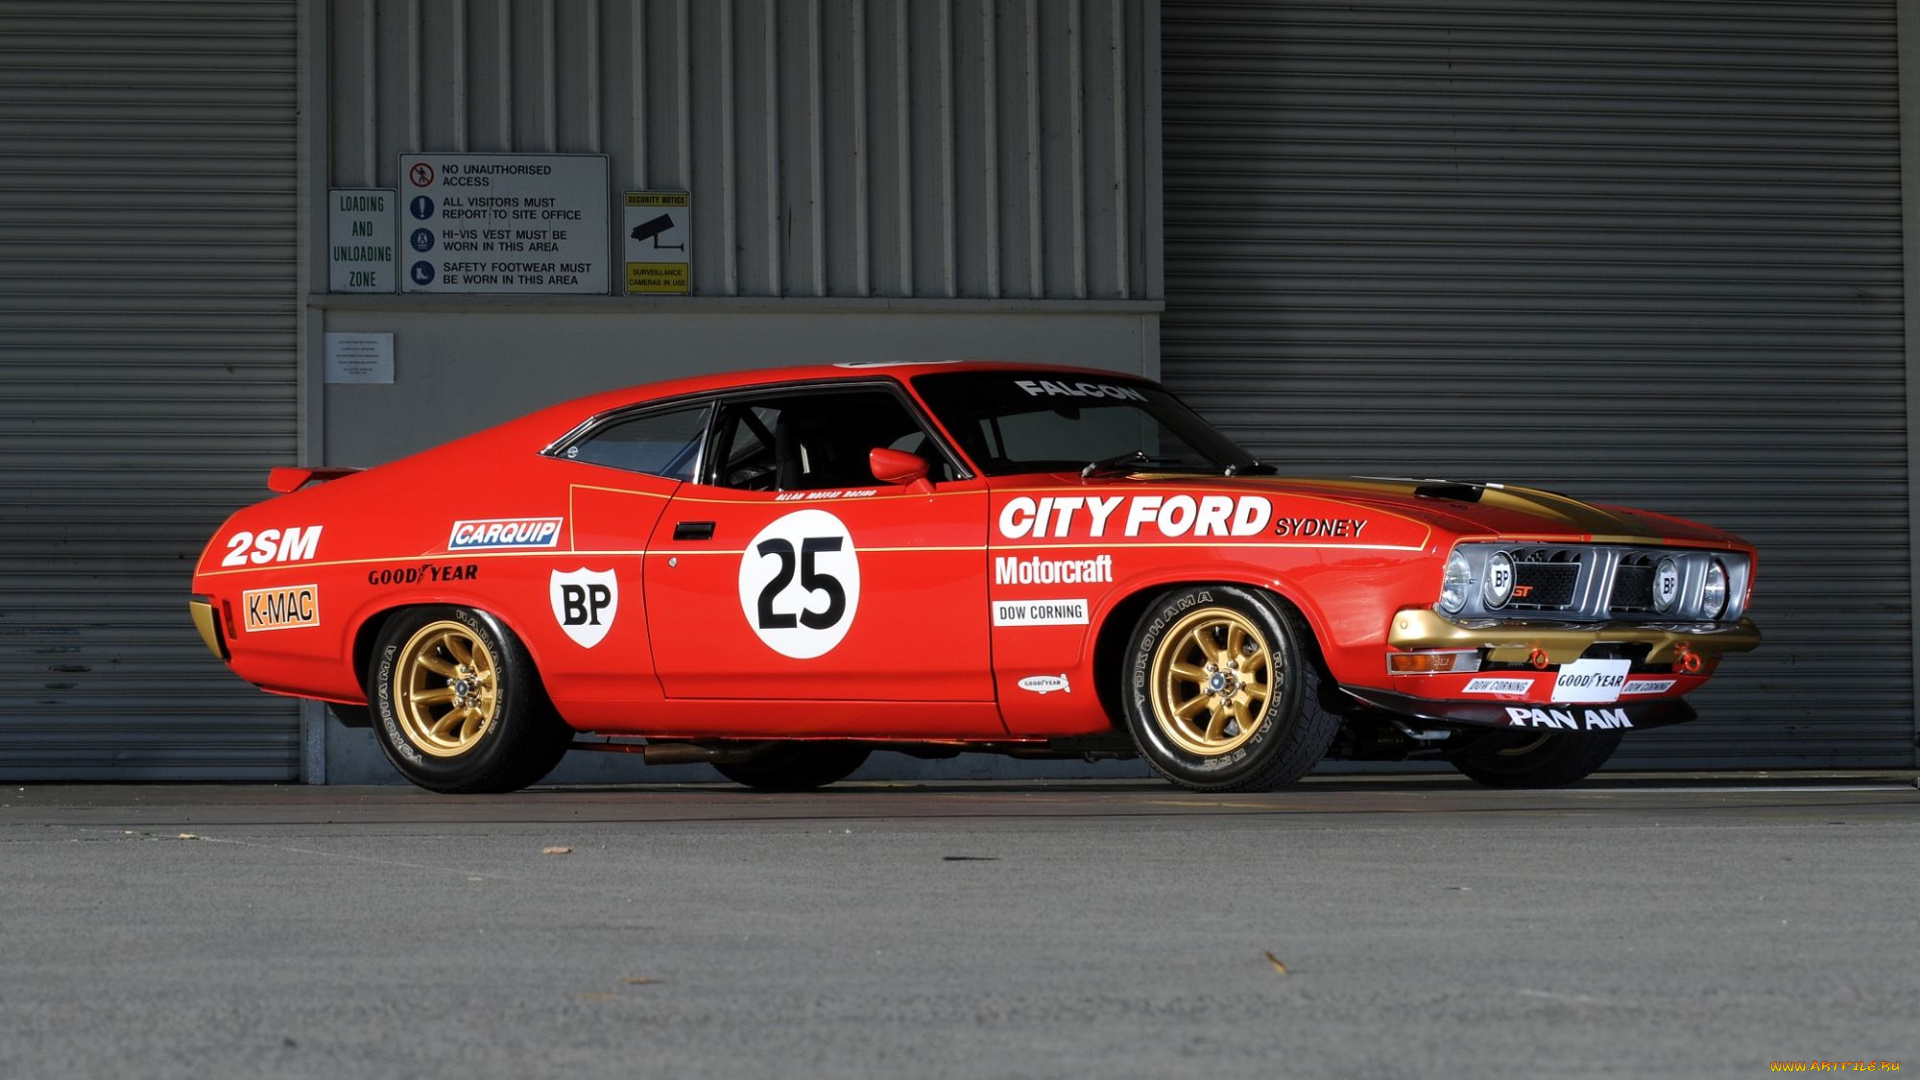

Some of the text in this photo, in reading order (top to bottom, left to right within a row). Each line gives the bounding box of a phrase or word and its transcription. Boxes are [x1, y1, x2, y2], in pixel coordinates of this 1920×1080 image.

[441, 165, 551, 176] NO UNAUTHORISED
[442, 177, 490, 187] ACCESS
[340, 196, 384, 212] LOADING
[442, 198, 556, 208] ALL VISITORS MUST
[628, 195, 685, 204] SECURITY NOTICE
[442, 209, 582, 221] REPORT TO SITE OFFICE
[352, 221, 373, 237] AND
[442, 230, 567, 240] HI-VIS VEST MUST BE
[333, 246, 391, 262] UNLOADING
[443, 242, 559, 252] WORN IN THIS AREA
[443, 262, 592, 273] SAFETY FOOTWEAR MUST
[632, 269, 683, 277] SURVEILLANCE
[350, 271, 376, 287] ZONE
[443, 275, 579, 285] BE WORN IN THIS AREA
[1014, 380, 1149, 402] FALCON
[998, 495, 1273, 539] CITY FORD
[455, 522, 557, 545] CARQUIP
[1274, 518, 1368, 538] SYDNEY
[221, 525, 323, 567] 2SM
[995, 554, 1113, 585] Motorcraft
[756, 536, 846, 630] 25
[1495, 570, 1509, 588] BP
[1663, 578, 1676, 595] BP
[250, 590, 312, 626] K-MAC
[560, 584, 612, 626] BP
[1000, 605, 1083, 620] DOW CORNING
[1134, 591, 1214, 709] YOKOHAMA
[1469, 681, 1529, 693] DOW CORNING
[378, 645, 424, 766] YOKOHAMA
[1250, 651, 1283, 744] RADIAL
[1505, 707, 1634, 730] PAN AM
